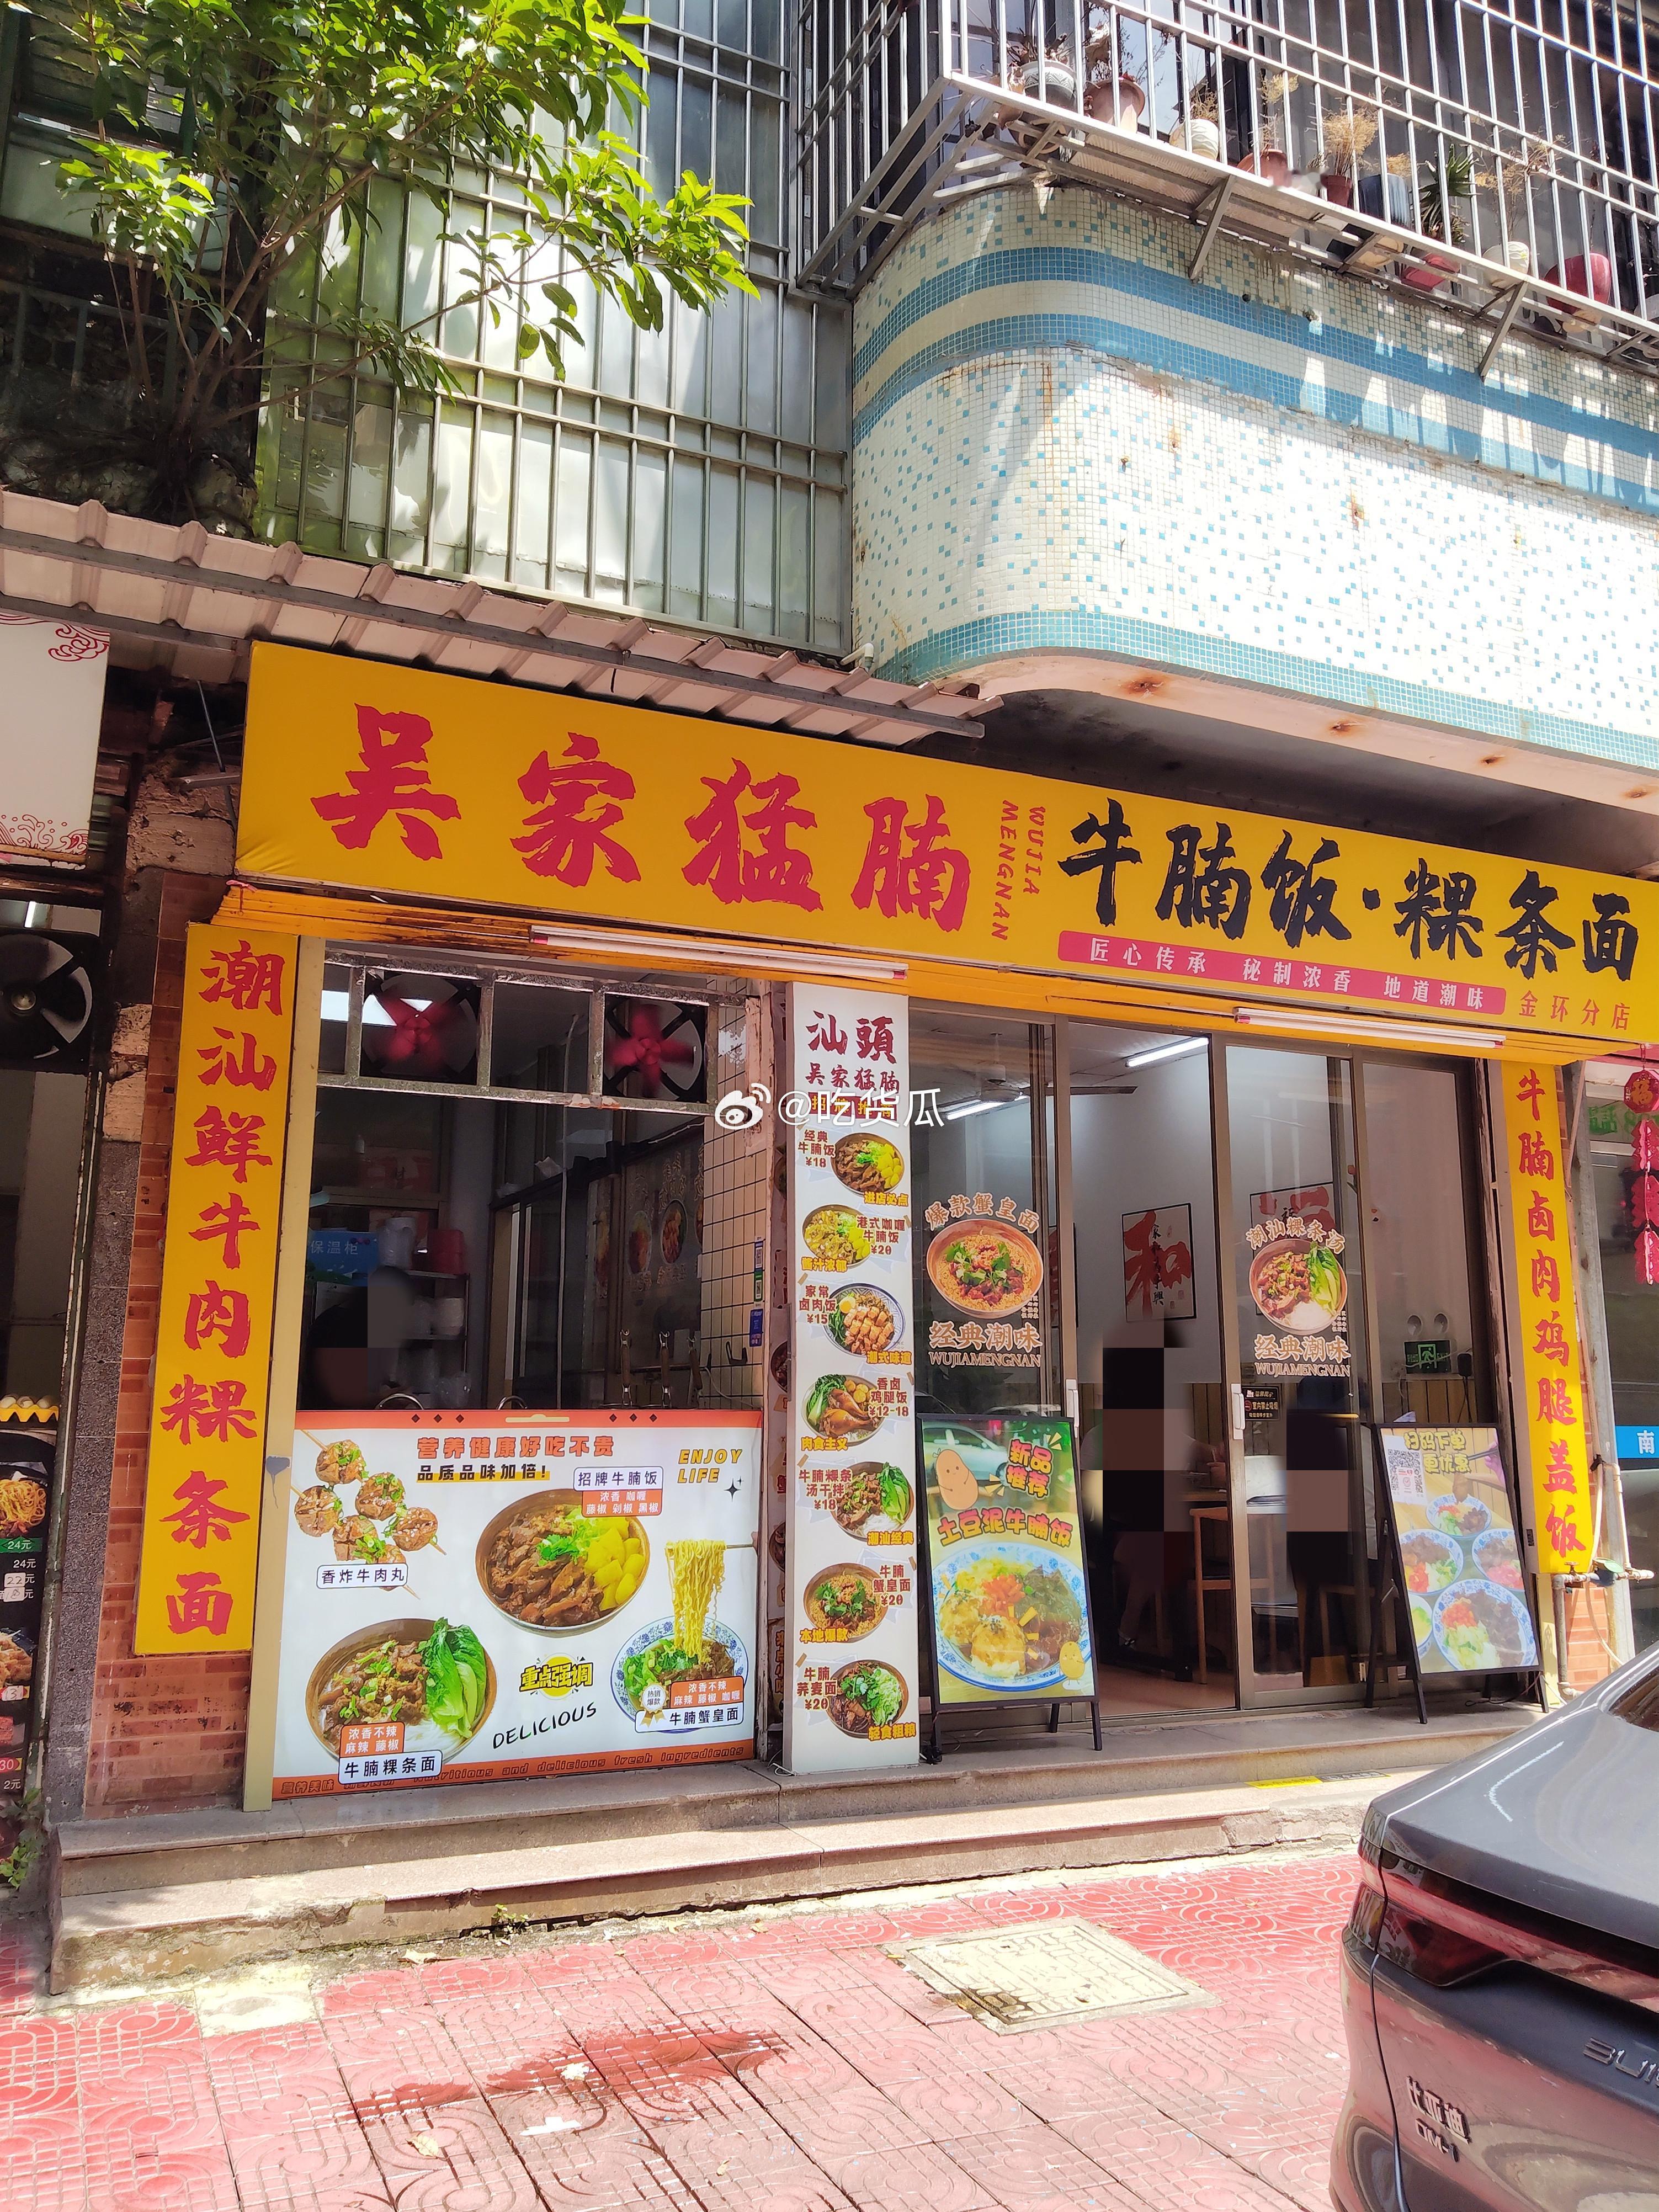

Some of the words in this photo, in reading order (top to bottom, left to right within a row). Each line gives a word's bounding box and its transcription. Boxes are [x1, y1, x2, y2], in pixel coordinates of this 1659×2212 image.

[310, 703, 971, 933] 吴家猛腩
[1023, 806, 1046, 896] WUJIA
[991, 800, 1019, 940] MENGNAN
[1091, 937, 1207, 974] 匠心传承
[1243, 958, 1351, 992] 秘制浓香
[1384, 976, 1483, 1009] 地道潮味
[1519, 991, 1630, 1030] 金环分店
[805, 1010, 897, 1065] 汕頭
[805, 1062, 900, 1094] 吴家猛腩
[804, 1130, 828, 1142] 经典
[798, 1142, 836, 1157] 牛腩饭
[805, 1157, 826, 1167] ¥18
[864, 1191, 909, 1207] 进店必点
[924, 1192, 1040, 1233] 爆款蟹皇面
[864, 1230, 899, 1243] 牛腩饭
[310, 1240, 359, 1255] 保温柜
[871, 1245, 891, 1255] ¥20
[159, 940, 285, 1636] 潮汕鲜牛肉粿条面
[805, 1285, 829, 1298] 家常
[799, 1299, 836, 1312] 卤肉饭
[807, 1314, 828, 1325] ¥15
[1516, 1068, 1585, 1559] 牛腩卤肉鸡腿盖饭
[929, 1321, 1043, 1352] 经典潮味
[1254, 1334, 1351, 1364] 经典潮味
[866, 1351, 912, 1365] 潮式味道
[928, 1352, 1041, 1368] WUJIAMENGNAN
[1255, 1362, 1350, 1378] WUJIAMENGNAN
[878, 1378, 900, 1391] 香卤
[871, 1391, 907, 1404] 鸡腿饭
[868, 1406, 909, 1417] ¥12-18
[801, 1437, 848, 1451] 肉食主义
[1404, 1429, 1466, 1450] 扫码下单
[1637, 1430, 1655, 1454] 南
[417, 1436, 614, 1459] 营养健康好吃不贵
[678, 1449, 742, 1464] ENJOY
[1009, 1439, 1053, 1475] 新品
[1423, 1453, 1471, 1474] 更优惠
[578, 1470, 658, 1487] 招牌牛腩饭
[678, 1468, 720, 1483] LIFE
[799, 1469, 852, 1483] 牛腩粿条
[1005, 1465, 1049, 1498] 推荐
[600, 1492, 620, 1502] 浓香
[626, 1491, 646, 1501] 咖喱
[806, 1483, 844, 1497] 汤干拌
[586, 1504, 607, 1514] 藤椒
[613, 1503, 632, 1514] 剁椒
[639, 1502, 658, 1513] 黑椒
[814, 1500, 837, 1511] ¥18
[8, 1540, 32, 1550] 24元
[866, 1531, 914, 1545] 潮汕经典
[13, 1559, 36, 1568] 24元
[322, 1568, 405, 1584] 香炸牛肉丸
[880, 1565, 904, 1578] 牛腩
[873, 1579, 911, 1593] 蟹皇面
[881, 1594, 903, 1605] ¥20
[800, 1628, 849, 1644] 本地爆款
[519, 1662, 593, 1693] 重点强调
[804, 1667, 830, 1681] 牛腩
[688, 1681, 727, 1693] 浓香不辣
[797, 1681, 836, 1696] 荞麦面
[674, 1695, 693, 1705] 麻辣
[698, 1693, 716, 1704] 藤椒
[805, 1698, 828, 1710] ¥20
[669, 1706, 738, 1726] 牛腩蟹皇面
[348, 1725, 397, 1740] 浓香不辣
[493, 1701, 597, 1749] DELICIOUS
[868, 1722, 916, 1741] 轻食粗粮
[344, 1741, 369, 1754] 麻辣
[375, 1739, 399, 1752] 藤椒
[344, 1756, 435, 1778] 牛腩粿条面
[502, 1764, 529, 1775] and
[538, 1758, 605, 1772] delicious
[614, 1754, 653, 1766] fresh
[661, 1747, 744, 1762] ingredients
[4, 1779, 21, 1789] 2元
[281, 1779, 334, 1794] 营养美味
[1407, 2076, 1472, 2144] 比亚迪
